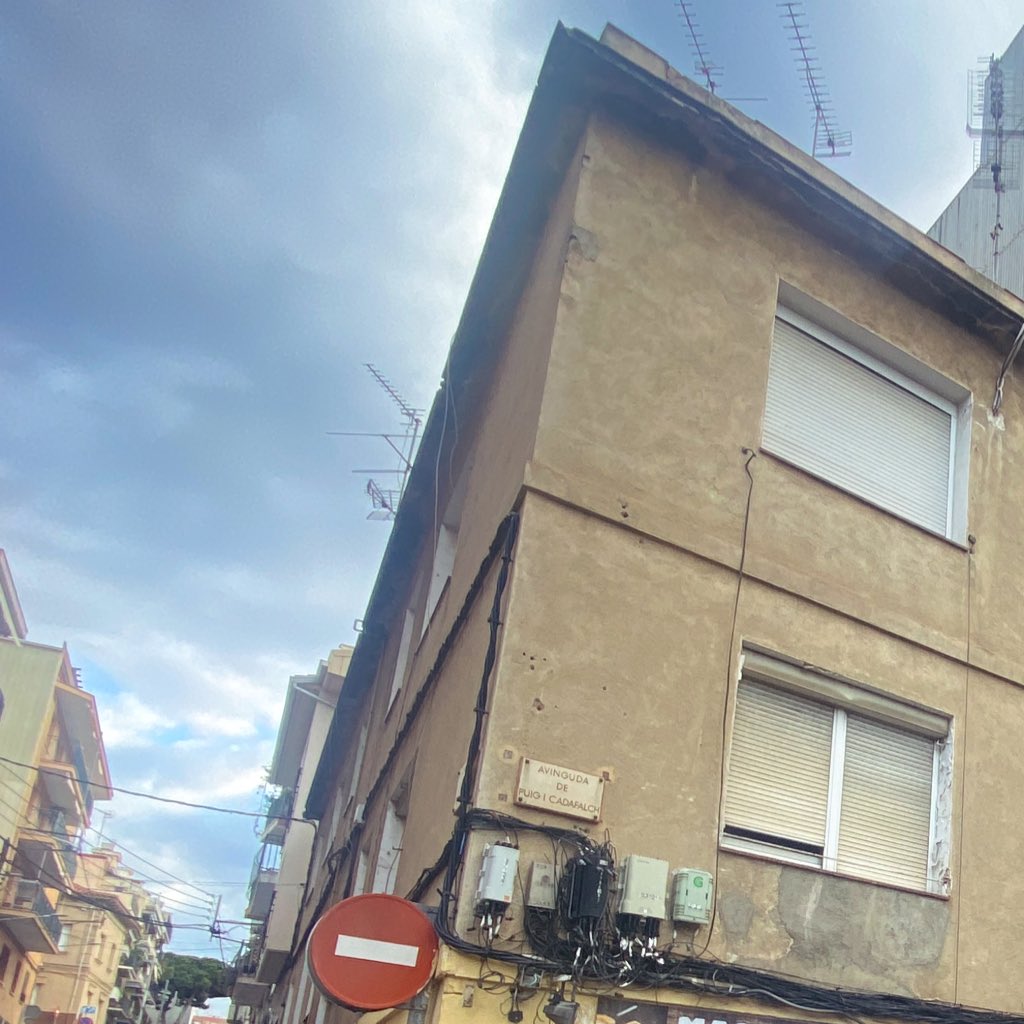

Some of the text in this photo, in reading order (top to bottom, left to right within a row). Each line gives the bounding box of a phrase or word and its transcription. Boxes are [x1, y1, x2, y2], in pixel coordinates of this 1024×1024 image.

[538, 765, 589, 785] AVINGUDA
[556, 782, 568, 793] DE
[519, 788, 600, 814] PUIG I CADAFALCH
